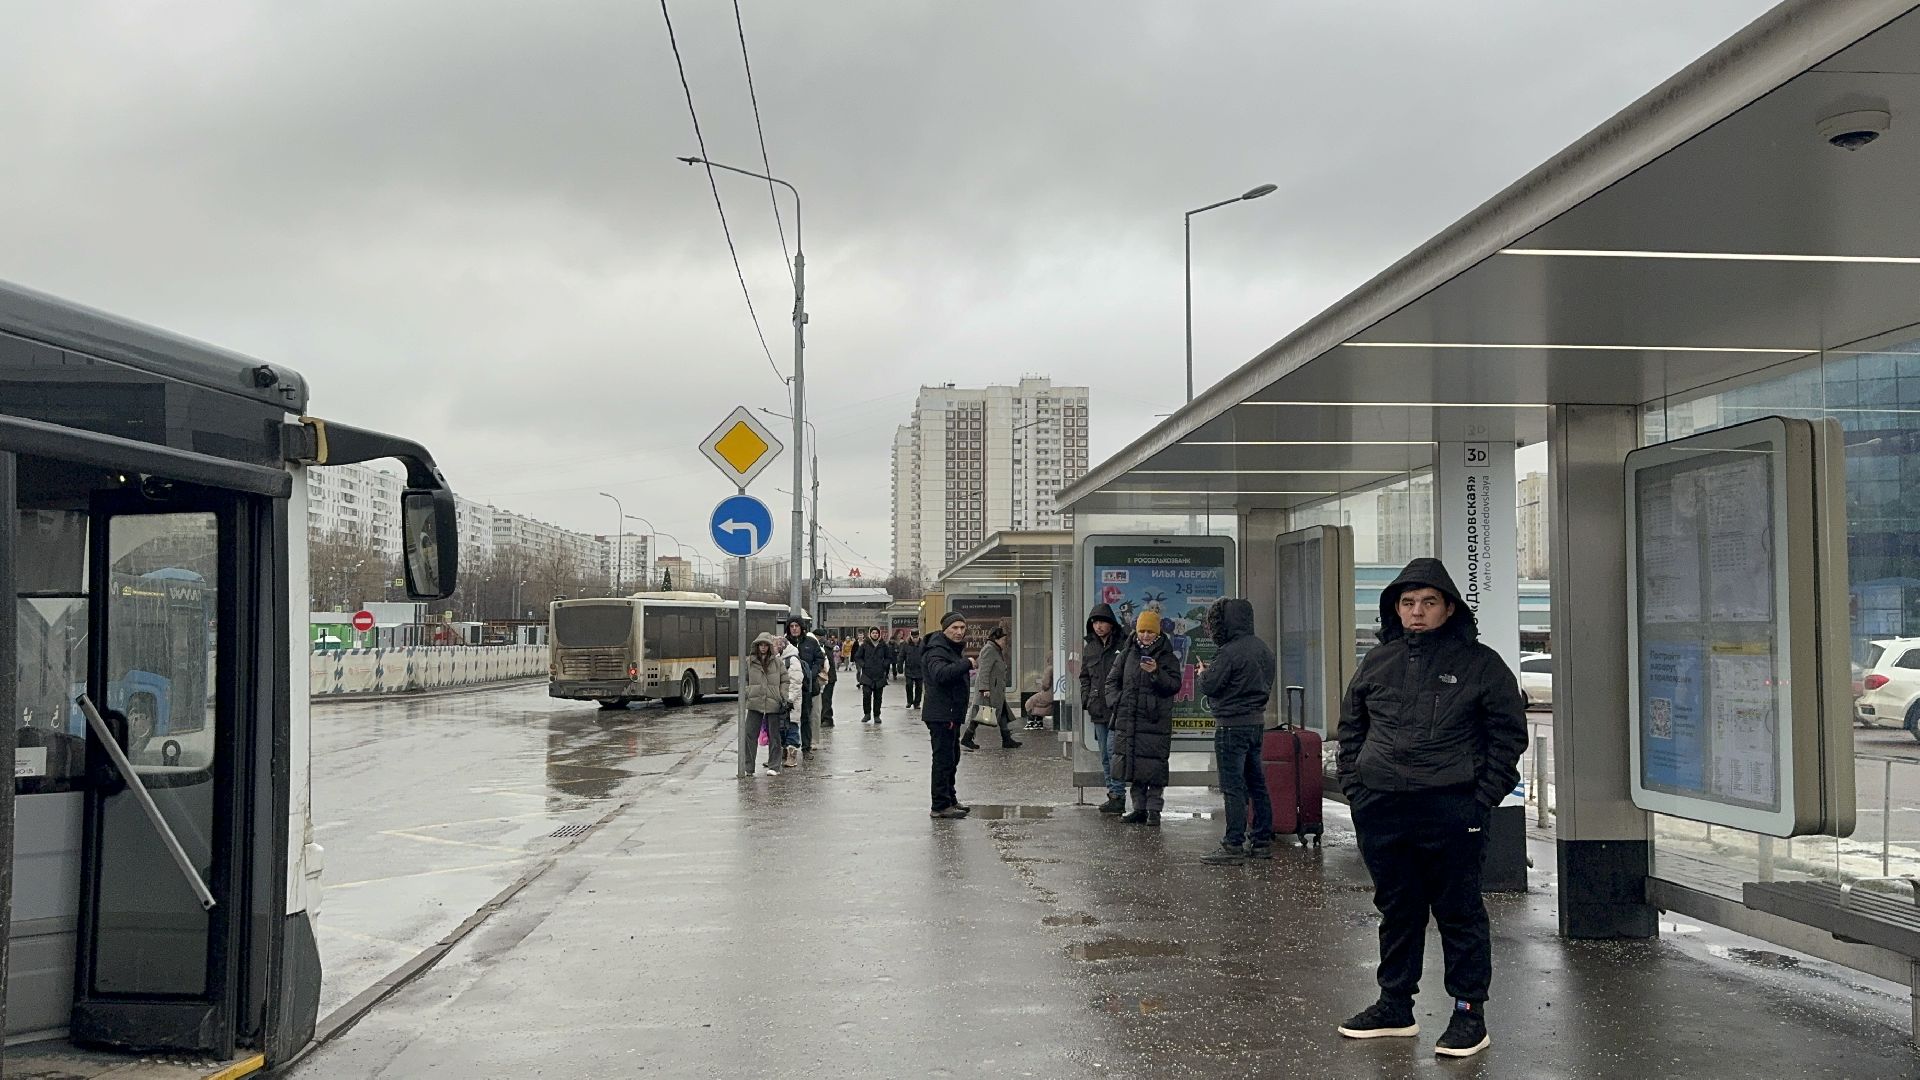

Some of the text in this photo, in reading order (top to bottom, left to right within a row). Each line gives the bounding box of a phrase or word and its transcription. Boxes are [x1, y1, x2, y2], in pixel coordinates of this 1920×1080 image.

[1467, 448, 1486, 462] 3D
[1465, 475, 1479, 612] «Домодедовская»
[1482, 475, 1492, 592] Metro Domodedovskaya
[1151, 569, 1218, 579] ИЛЬЯ АВЕРБУХ
